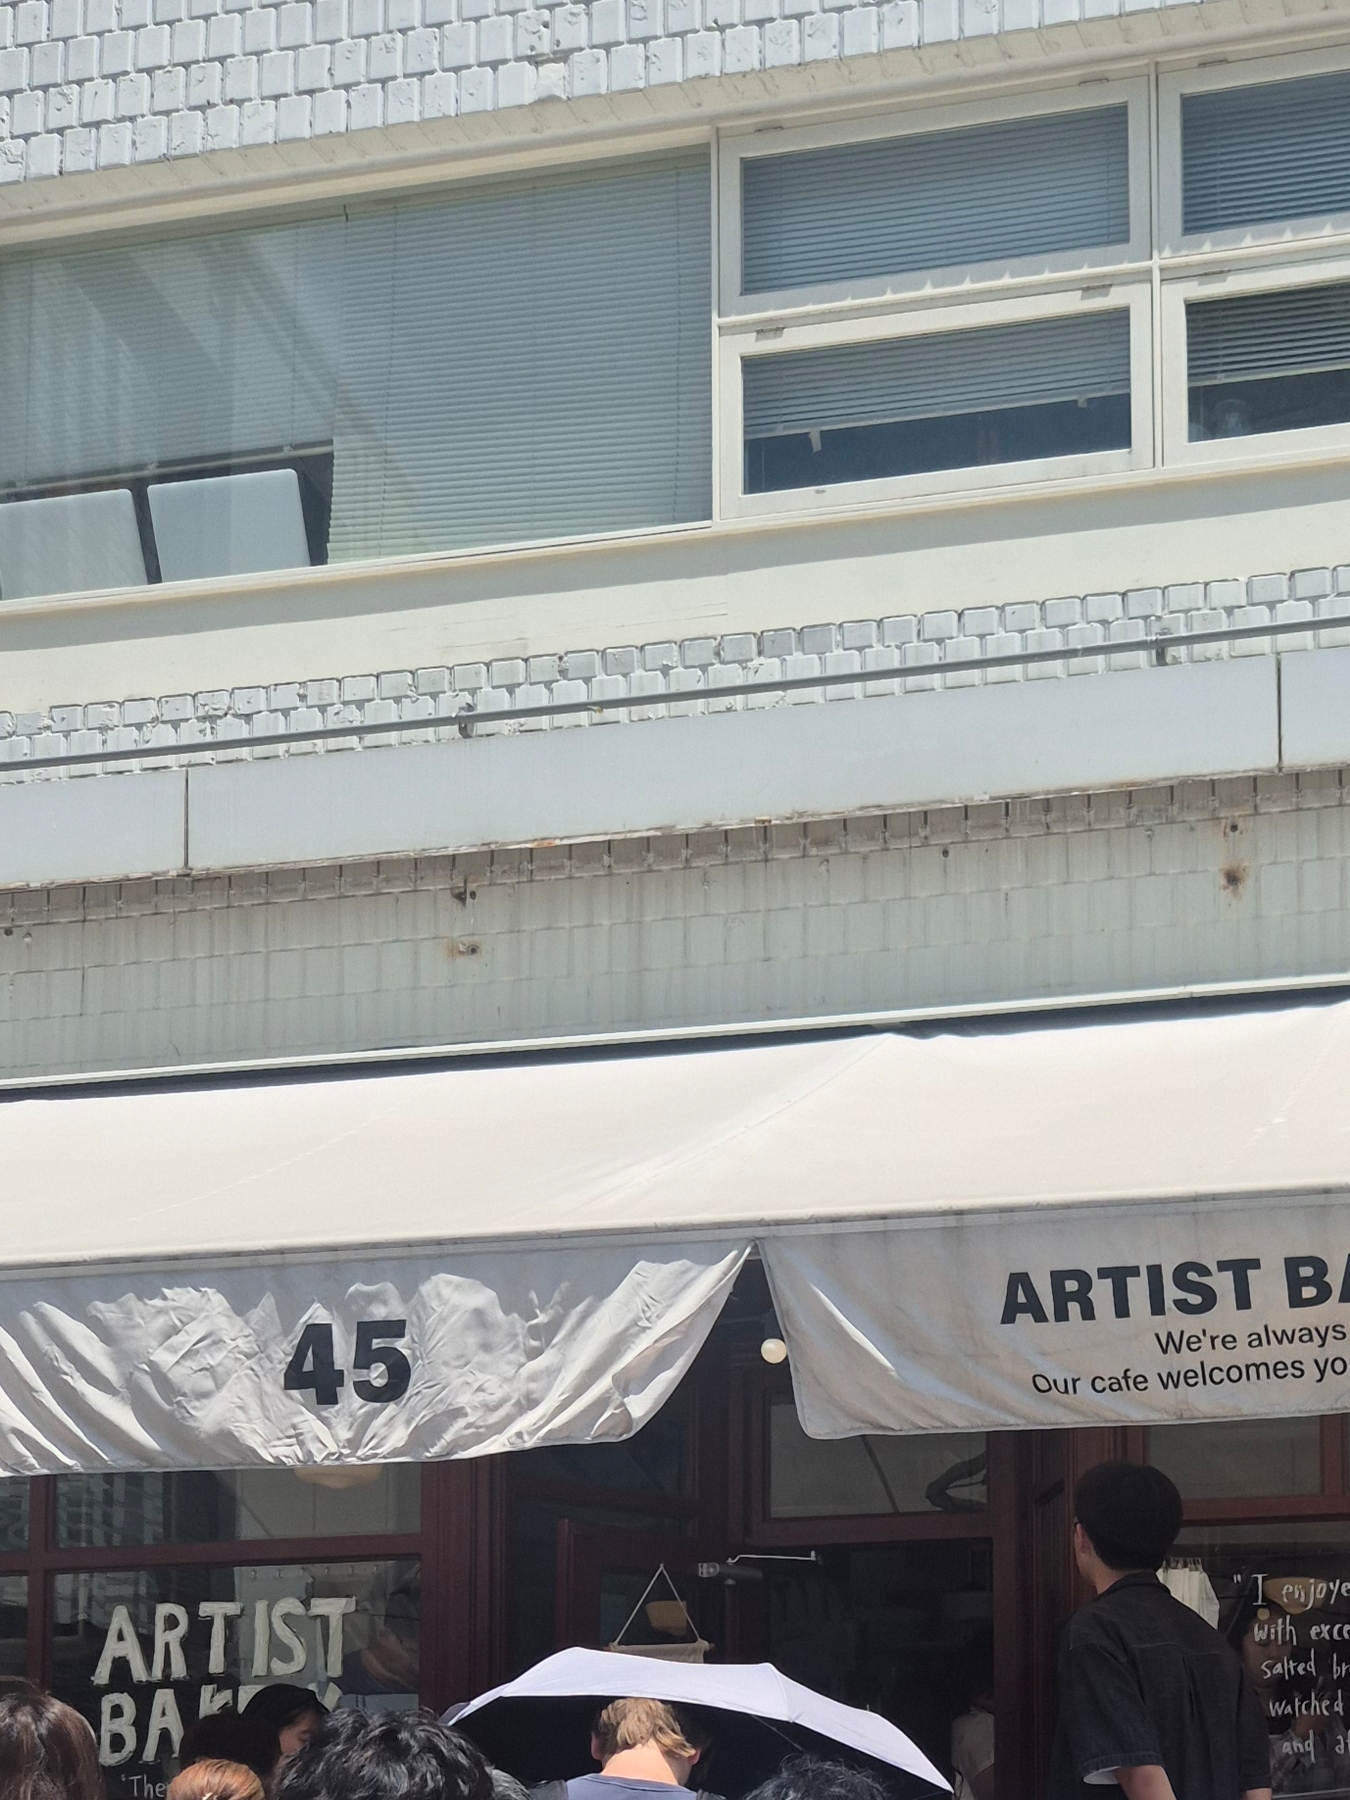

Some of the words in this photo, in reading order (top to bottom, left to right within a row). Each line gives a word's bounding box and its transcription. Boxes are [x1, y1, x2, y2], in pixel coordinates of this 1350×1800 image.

[1000, 1258, 1261, 1324] ARTIST
[1154, 1328, 1237, 1355] We're
[1247, 1324, 1347, 1348] always
[283, 1319, 412, 1405] 45
[1032, 1373, 1081, 1395] Our
[1091, 1369, 1149, 1394] cafe
[1157, 1358, 1305, 1390] welcomes
[90, 1596, 356, 1686] ARTIST
[1253, 1614, 1298, 1646] with
[1269, 1689, 1344, 1718] watched
[1282, 1729, 1315, 1764] and
